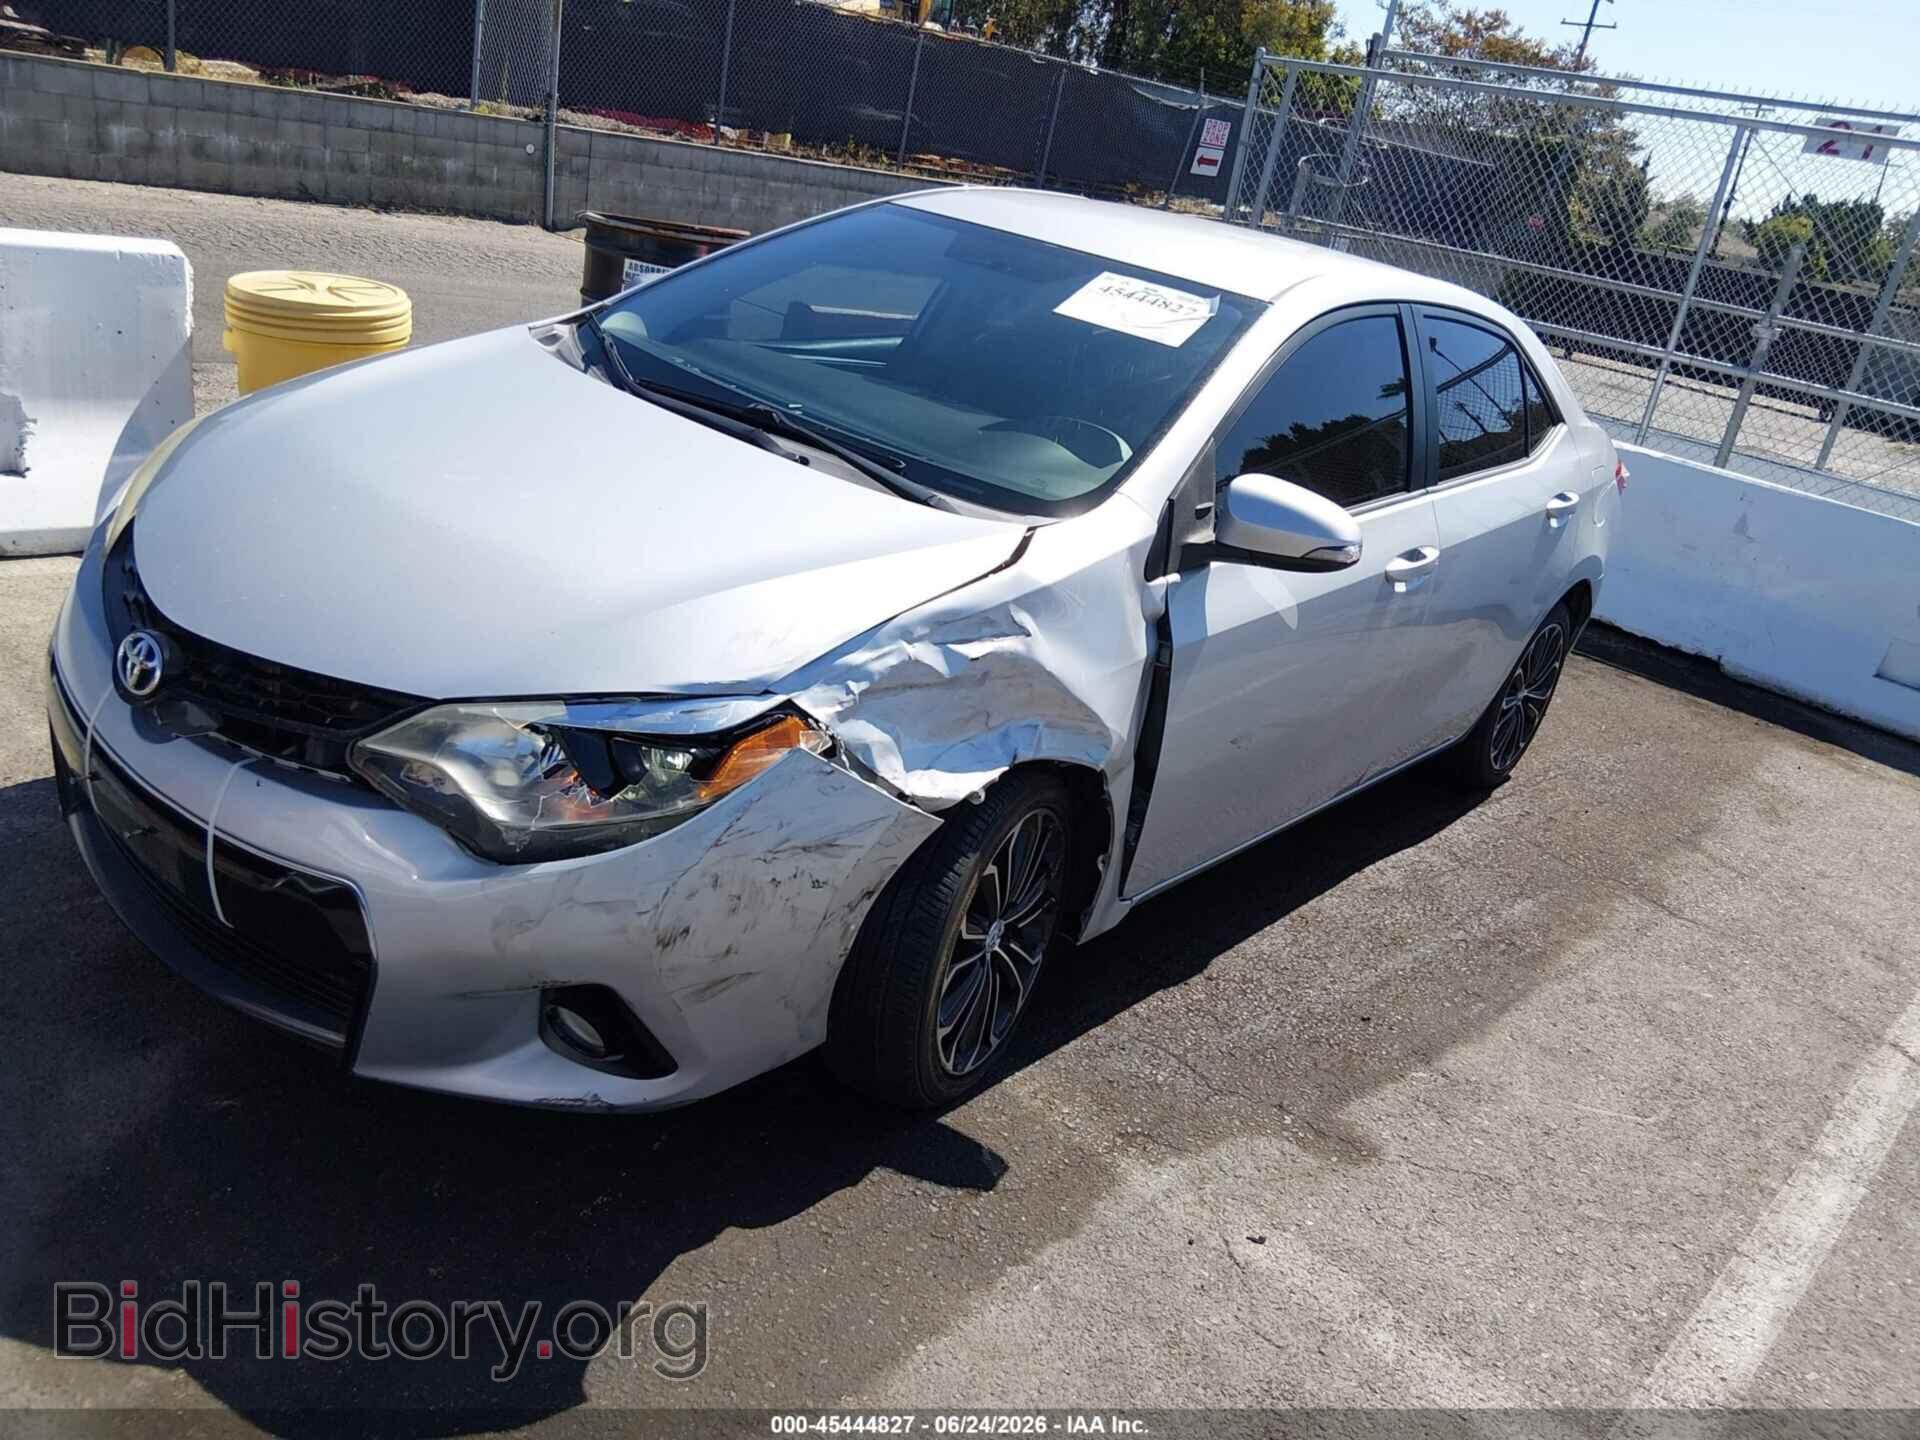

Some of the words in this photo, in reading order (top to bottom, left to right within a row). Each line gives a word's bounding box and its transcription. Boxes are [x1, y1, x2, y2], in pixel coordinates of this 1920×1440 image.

[1206, 119, 1229, 132] DROP
[1816, 120, 1883, 160] 21
[1099, 285, 1198, 315] 45444827
